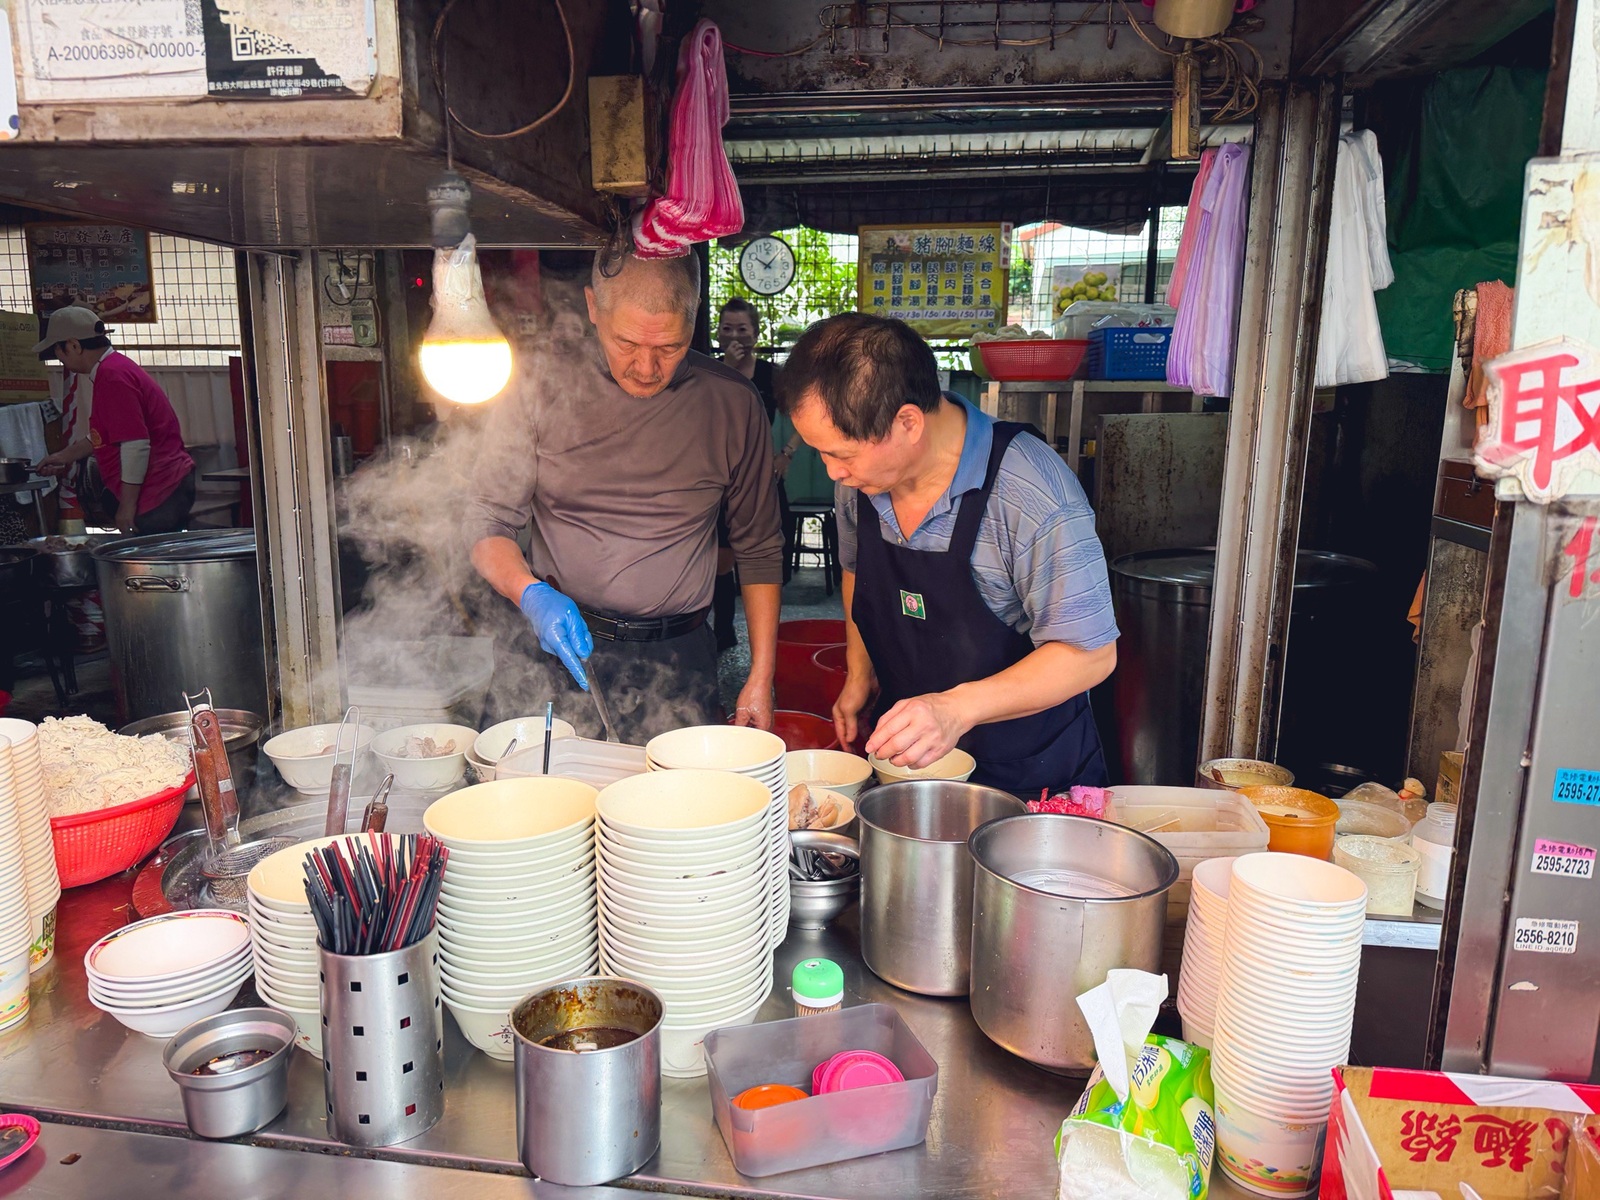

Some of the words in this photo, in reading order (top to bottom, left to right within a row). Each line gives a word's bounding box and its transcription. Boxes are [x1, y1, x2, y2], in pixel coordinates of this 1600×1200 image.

[763, 242, 772, 251] 12
[913, 233, 996, 256] 豬腳麵線
[746, 262, 753, 270] 9
[782, 261, 789, 270] 3
[749, 271, 756, 280] 8
[757, 279, 764, 287] 7
[764, 281, 771, 290] 6
[773, 278, 780, 287] 5
[906, 311, 920, 319] 130
[924, 310, 939, 318] 150
[942, 311, 957, 319] 130
[960, 310, 974, 319] 150
[979, 310, 995, 318] 130
[1498, 353, 1600, 490] 取
[1516, 929, 1574, 946] 2556-8210
